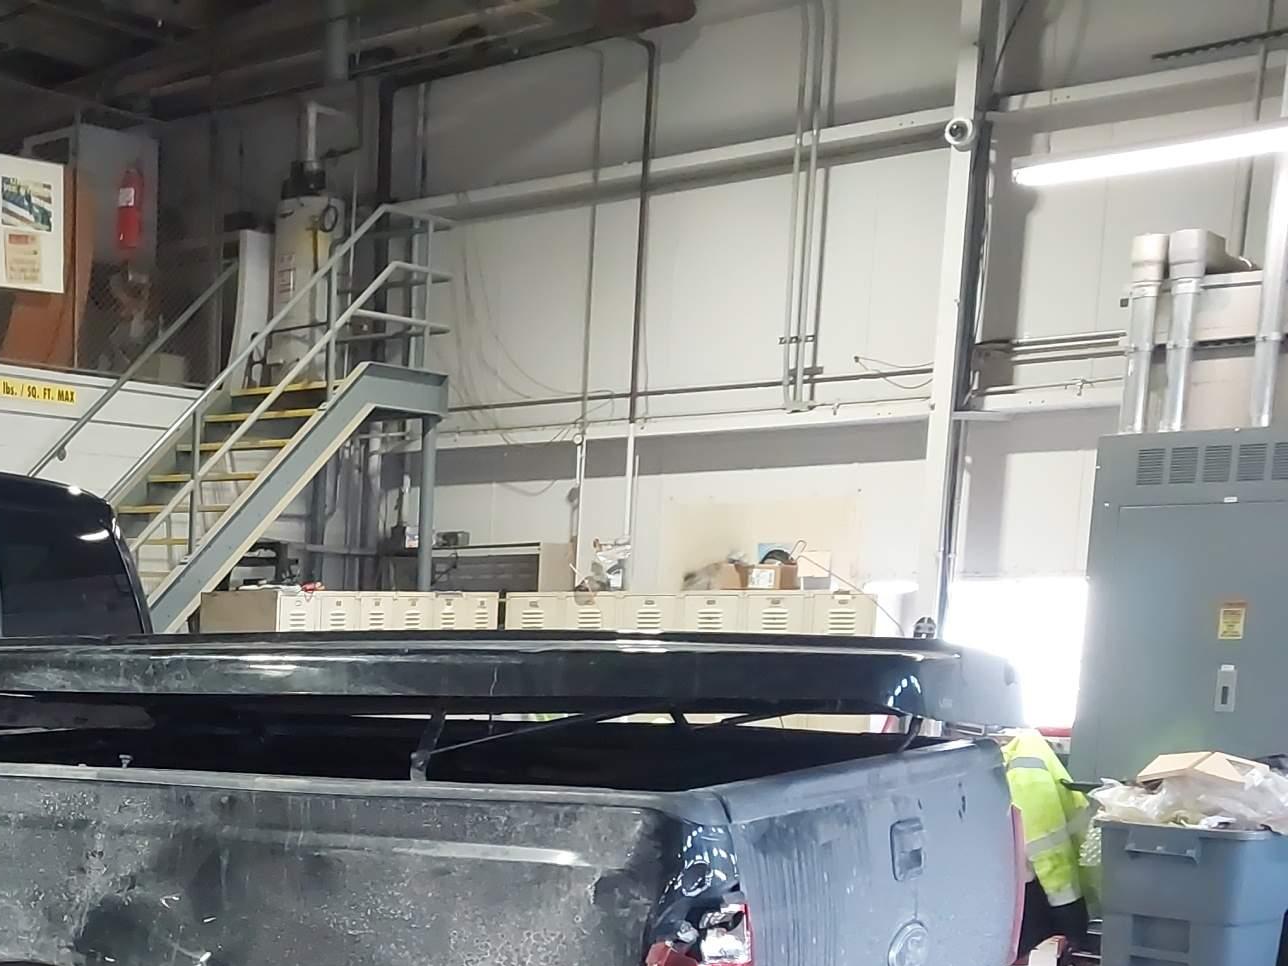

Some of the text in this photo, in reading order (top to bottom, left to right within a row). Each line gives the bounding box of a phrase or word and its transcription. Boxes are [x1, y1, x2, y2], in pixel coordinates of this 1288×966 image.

[2, 381, 18, 396] lbs.
[27, 385, 40, 399] SQ.
[43, 387, 54, 401] FT.
[57, 389, 75, 403] MAX
